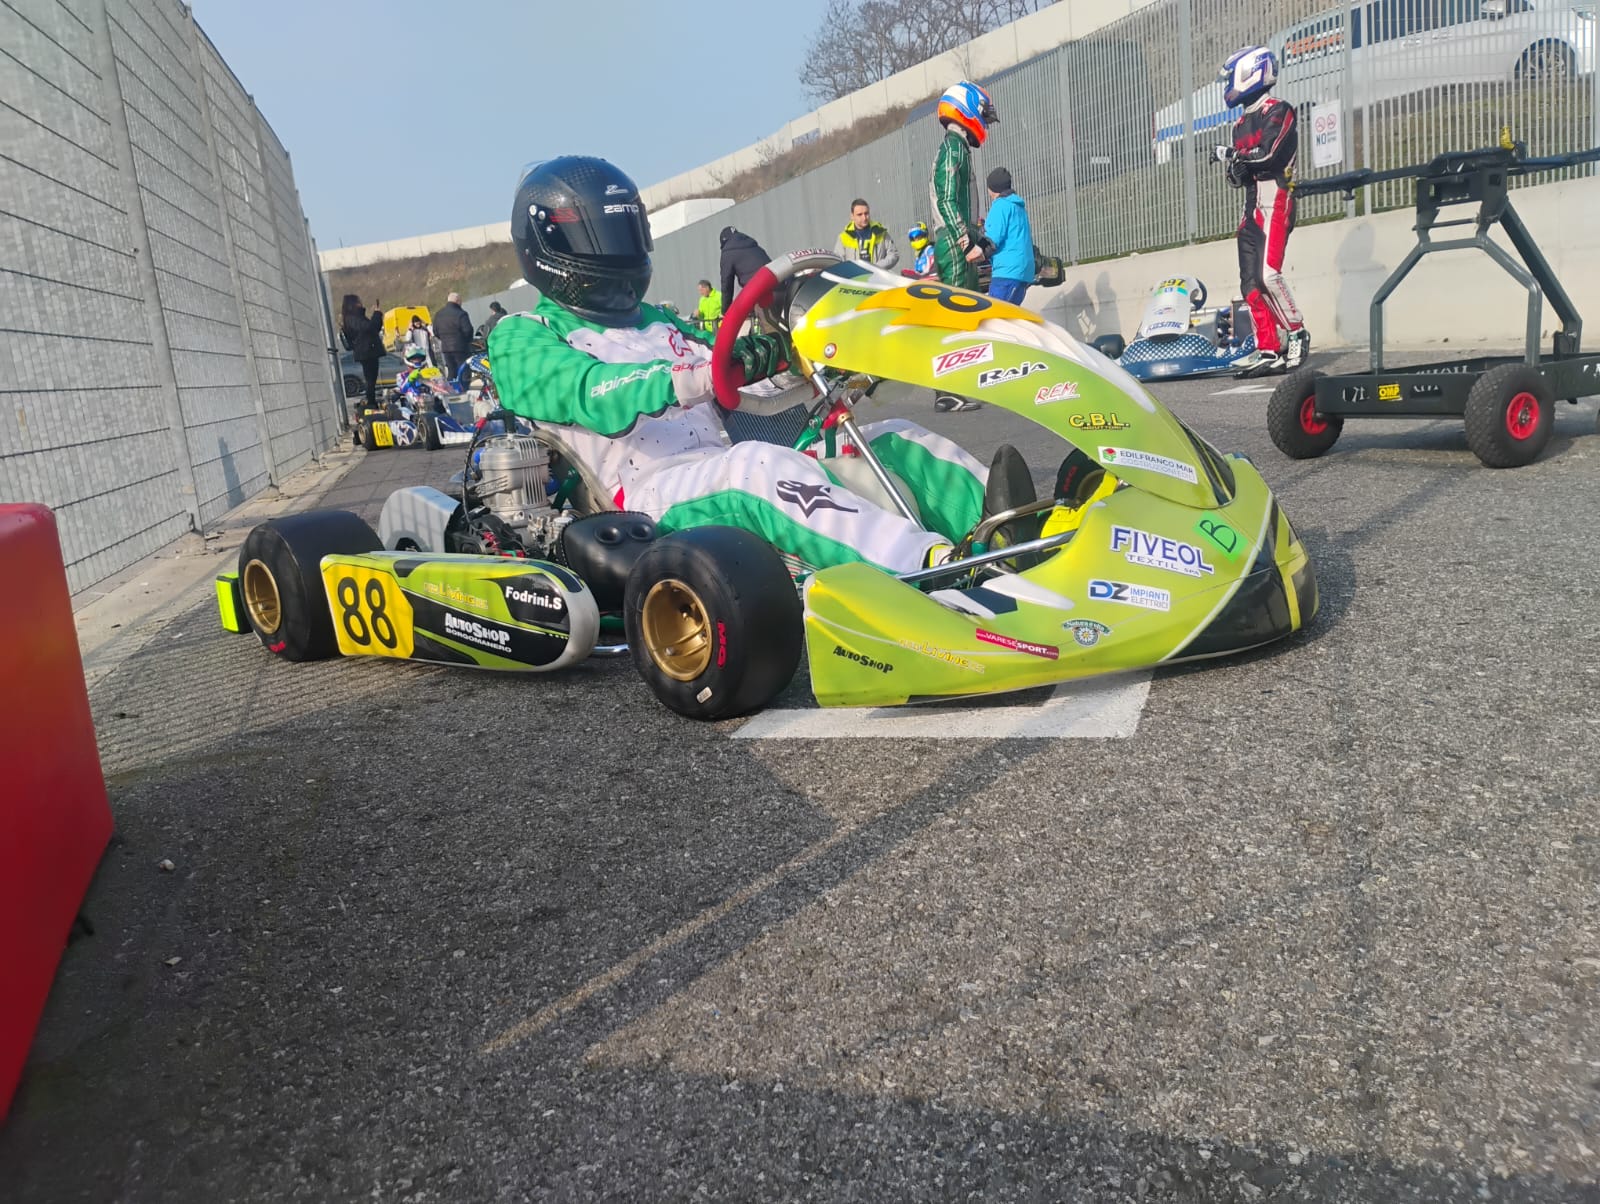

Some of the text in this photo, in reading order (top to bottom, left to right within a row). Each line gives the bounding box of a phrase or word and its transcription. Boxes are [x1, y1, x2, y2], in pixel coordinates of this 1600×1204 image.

[603, 203, 640, 214] zamp
[1379, 386, 1400, 398] OMP
[1120, 450, 1194, 474] EDILFRANCO MAR
[1199, 519, 1237, 554] B
[1111, 527, 1213, 572] FIVEOL
[1127, 554, 1178, 570] TEXTIL
[505, 586, 562, 610] Fodrini.S
[1090, 580, 1169, 601] DZ IMPIANTI
[337, 576, 398, 649] 88
[445, 628, 512, 653] BORGOMANERO
